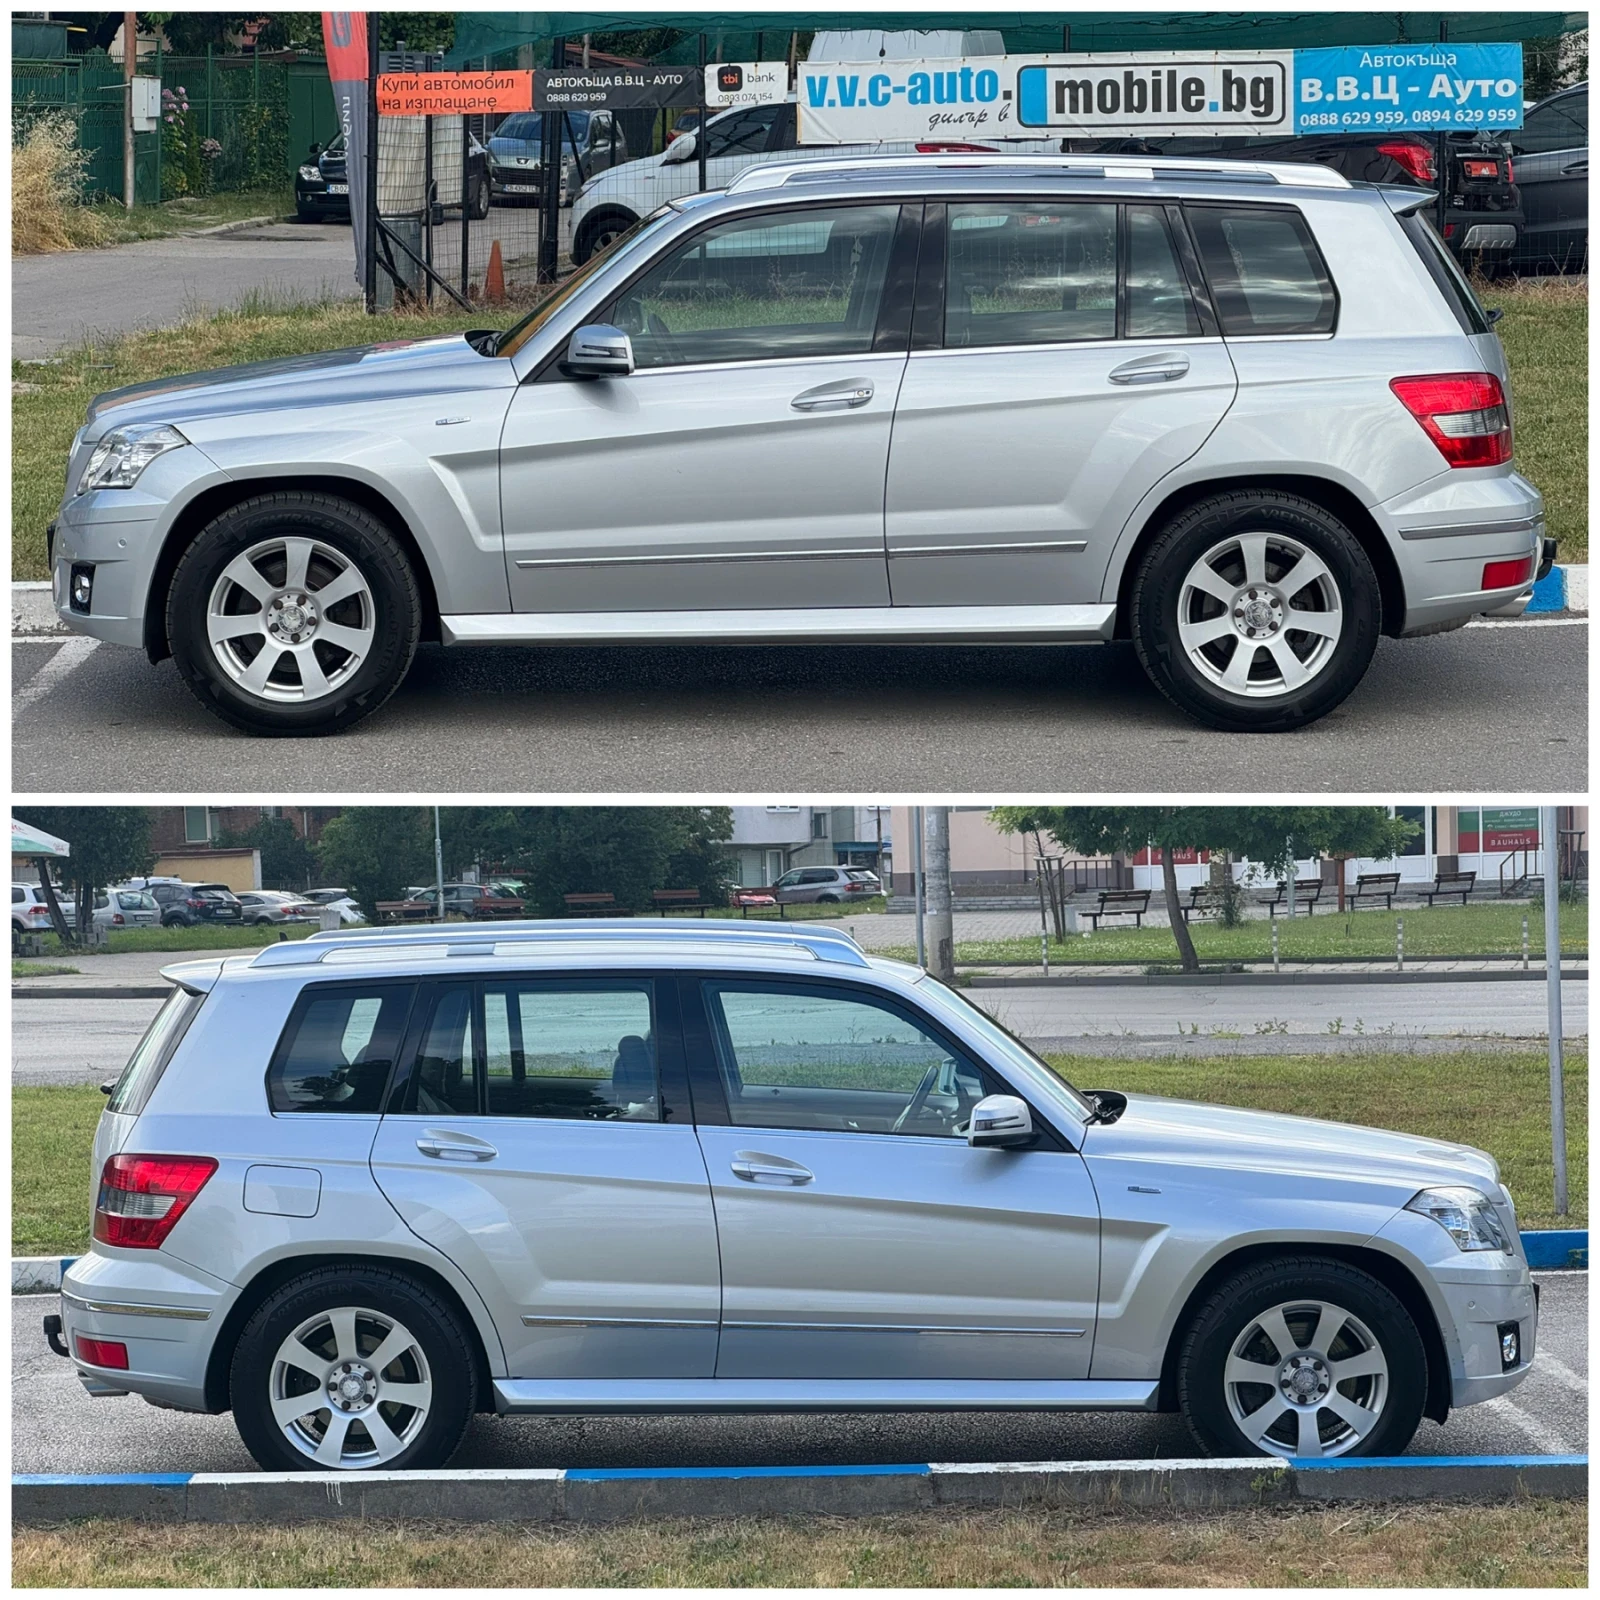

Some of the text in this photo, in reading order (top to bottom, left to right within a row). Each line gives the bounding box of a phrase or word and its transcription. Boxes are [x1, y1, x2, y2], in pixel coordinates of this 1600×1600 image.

[1359, 52, 1457, 68] Автокъща
[382, 76, 514, 93] Купи автомобил
[547, 76, 612, 88] АВТОКЪЩА
[614, 75, 644, 87] В.В.Ц
[653, 74, 683, 86] АУТО
[722, 73, 776, 84] tbi bank
[1055, 69, 1274, 117] mobile.bg
[1301, 75, 1399, 105] В.В.Ц
[1428, 73, 1517, 104] Ауто
[383, 96, 497, 110] на изплащане
[546, 92, 607, 102] 0888 629 959
[718, 94, 740, 103] 0893
[758, 92, 773, 101] 154
[929, 108, 988, 131] дилър
[1300, 109, 1517, 127] 0888 629 959, 0894 629 959
[1490, 838, 1531, 846] BAUHAUS
[1157, 852, 1192, 861] BHAUS
